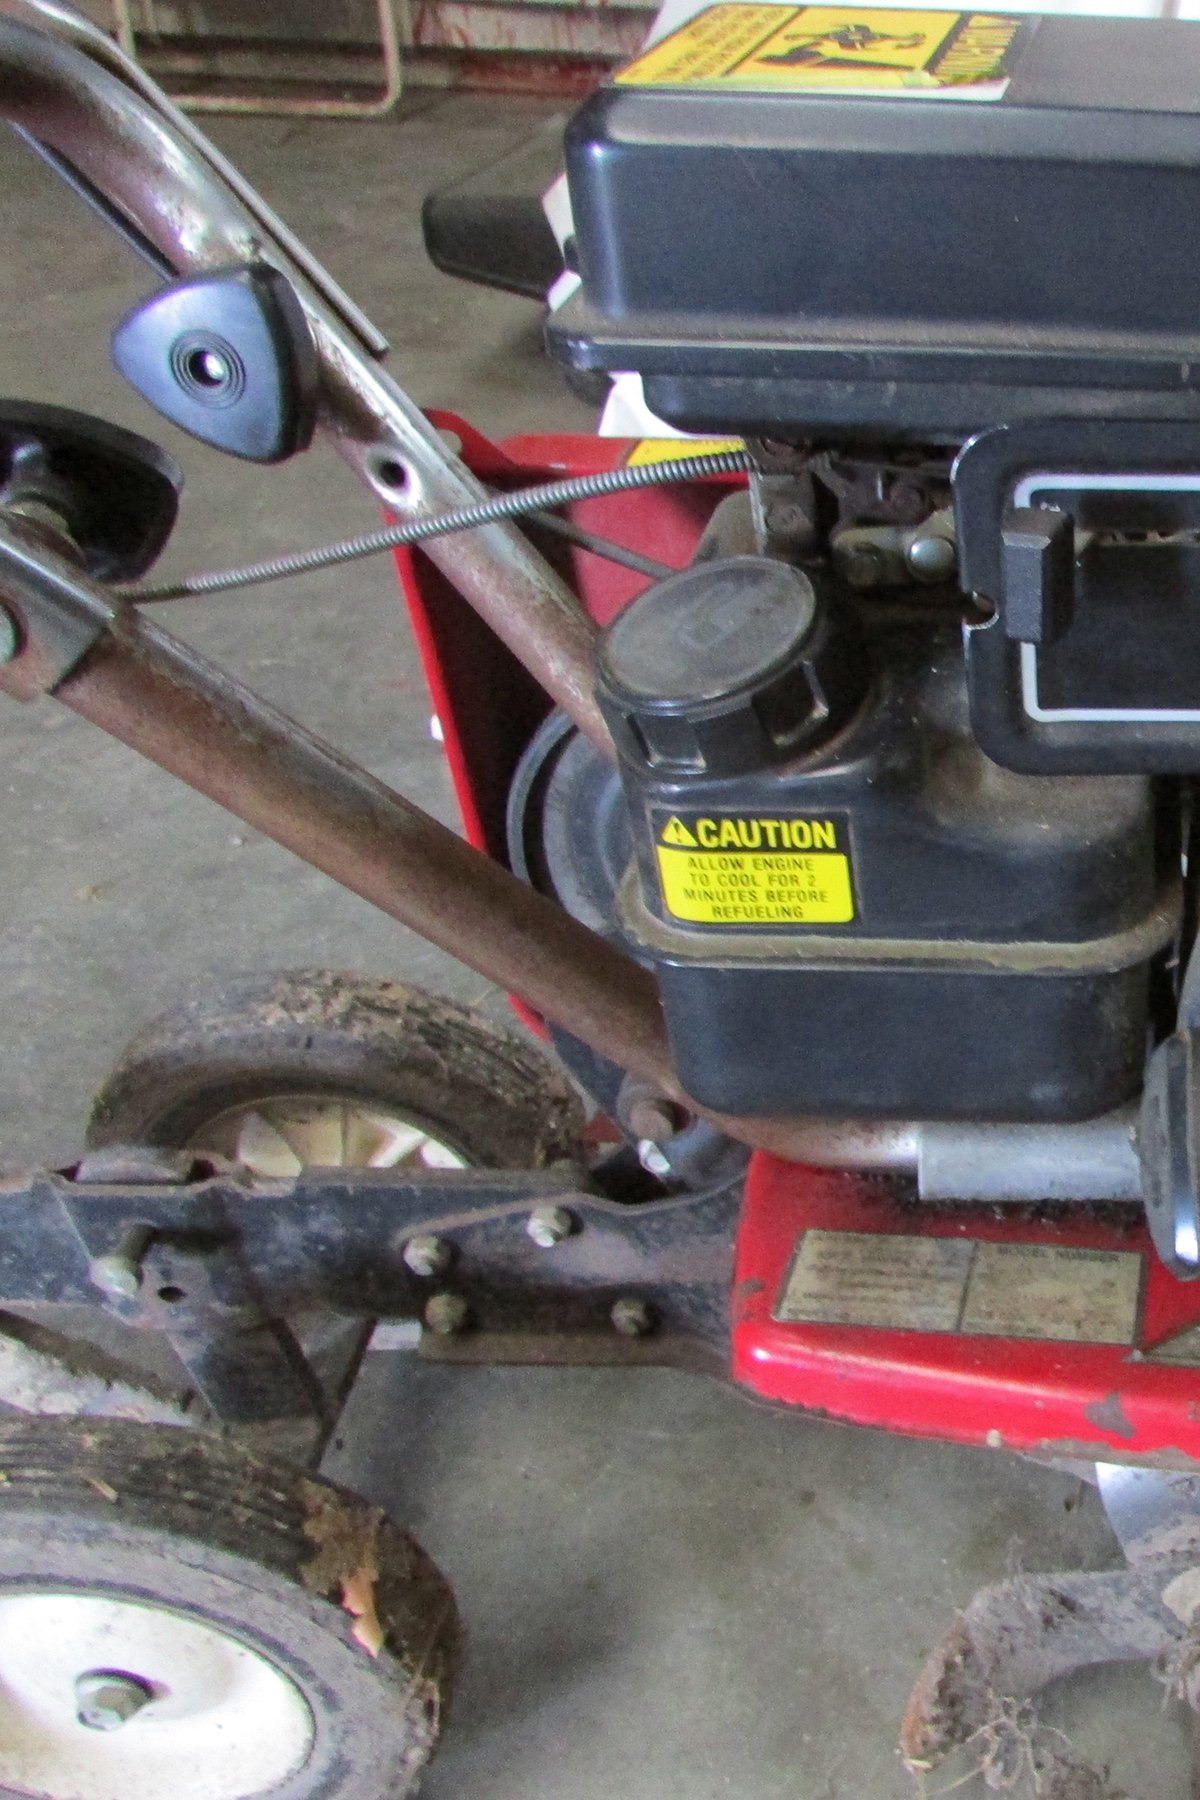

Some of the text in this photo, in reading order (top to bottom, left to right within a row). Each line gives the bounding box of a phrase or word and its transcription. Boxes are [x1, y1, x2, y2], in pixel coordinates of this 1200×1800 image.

[696, 818, 837, 849] CAUTION
[688, 857, 815, 871] ALLOW ENGINE
[690, 873, 817, 887] TO COOL FOR 2
[683, 888, 829, 903] MINUTES BEFORE
[712, 905, 805, 919] REFUELING
